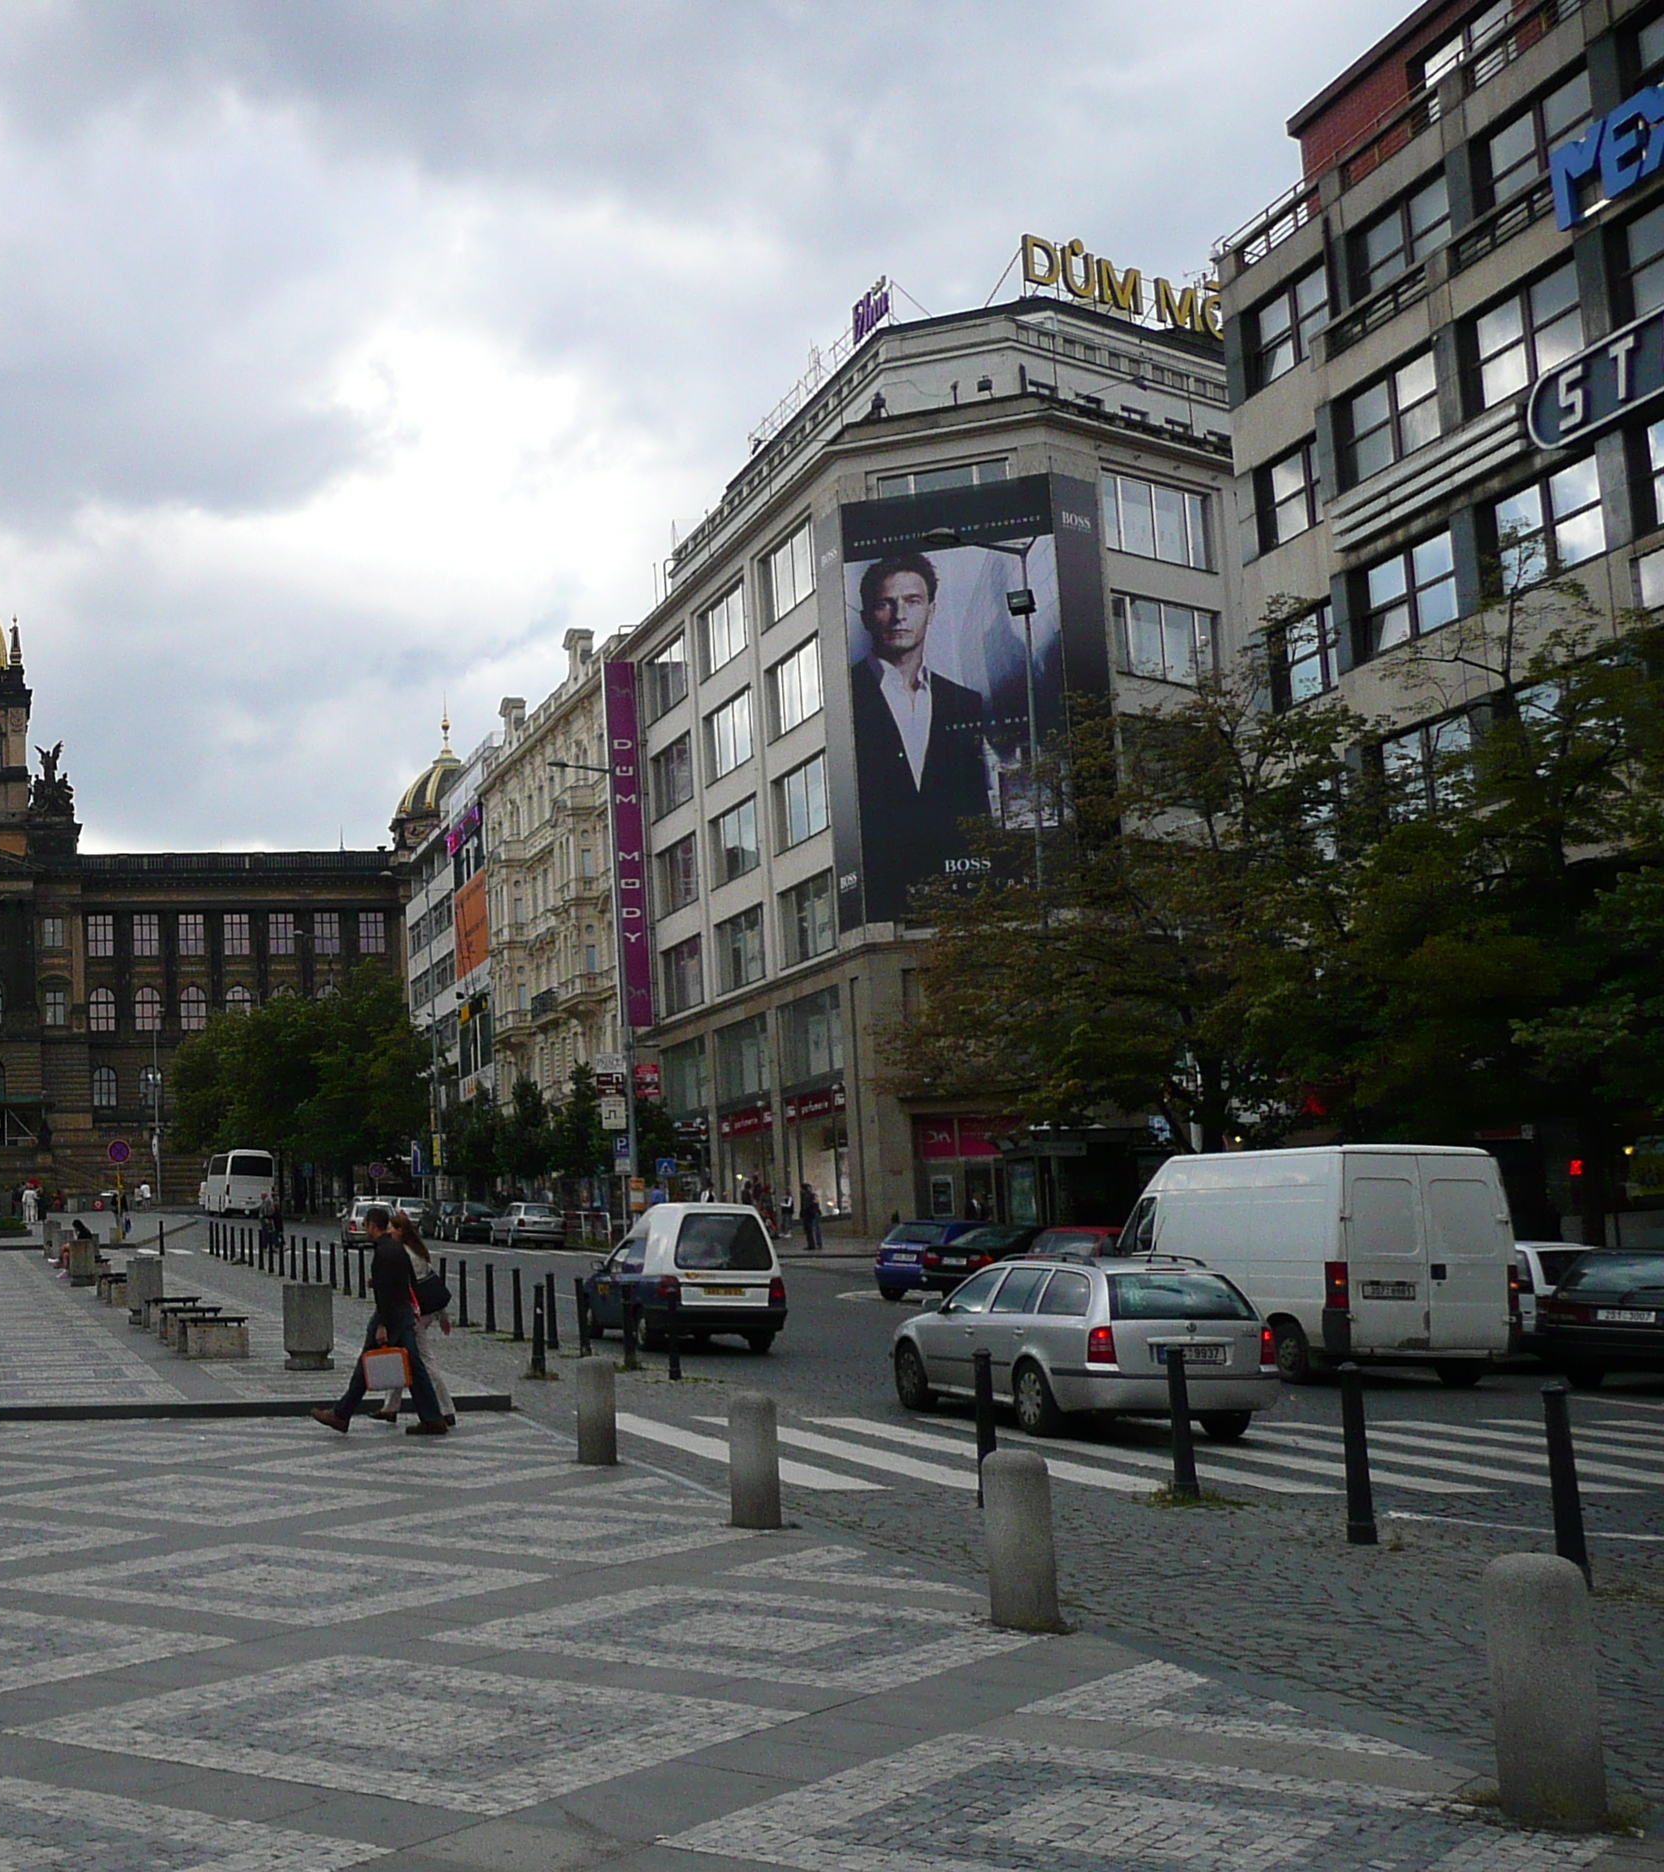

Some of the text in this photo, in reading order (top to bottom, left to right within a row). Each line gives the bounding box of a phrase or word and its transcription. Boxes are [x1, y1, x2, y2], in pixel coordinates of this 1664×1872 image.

[1021, 233, 1143, 314] DŮM
[1062, 511, 1091, 529] BOSS
[945, 721, 982, 731] LEAVE
[1004, 716, 1028, 724] MAR
[945, 857, 991, 873] BOSS
[1194, 1348, 1220, 1359] 9937
